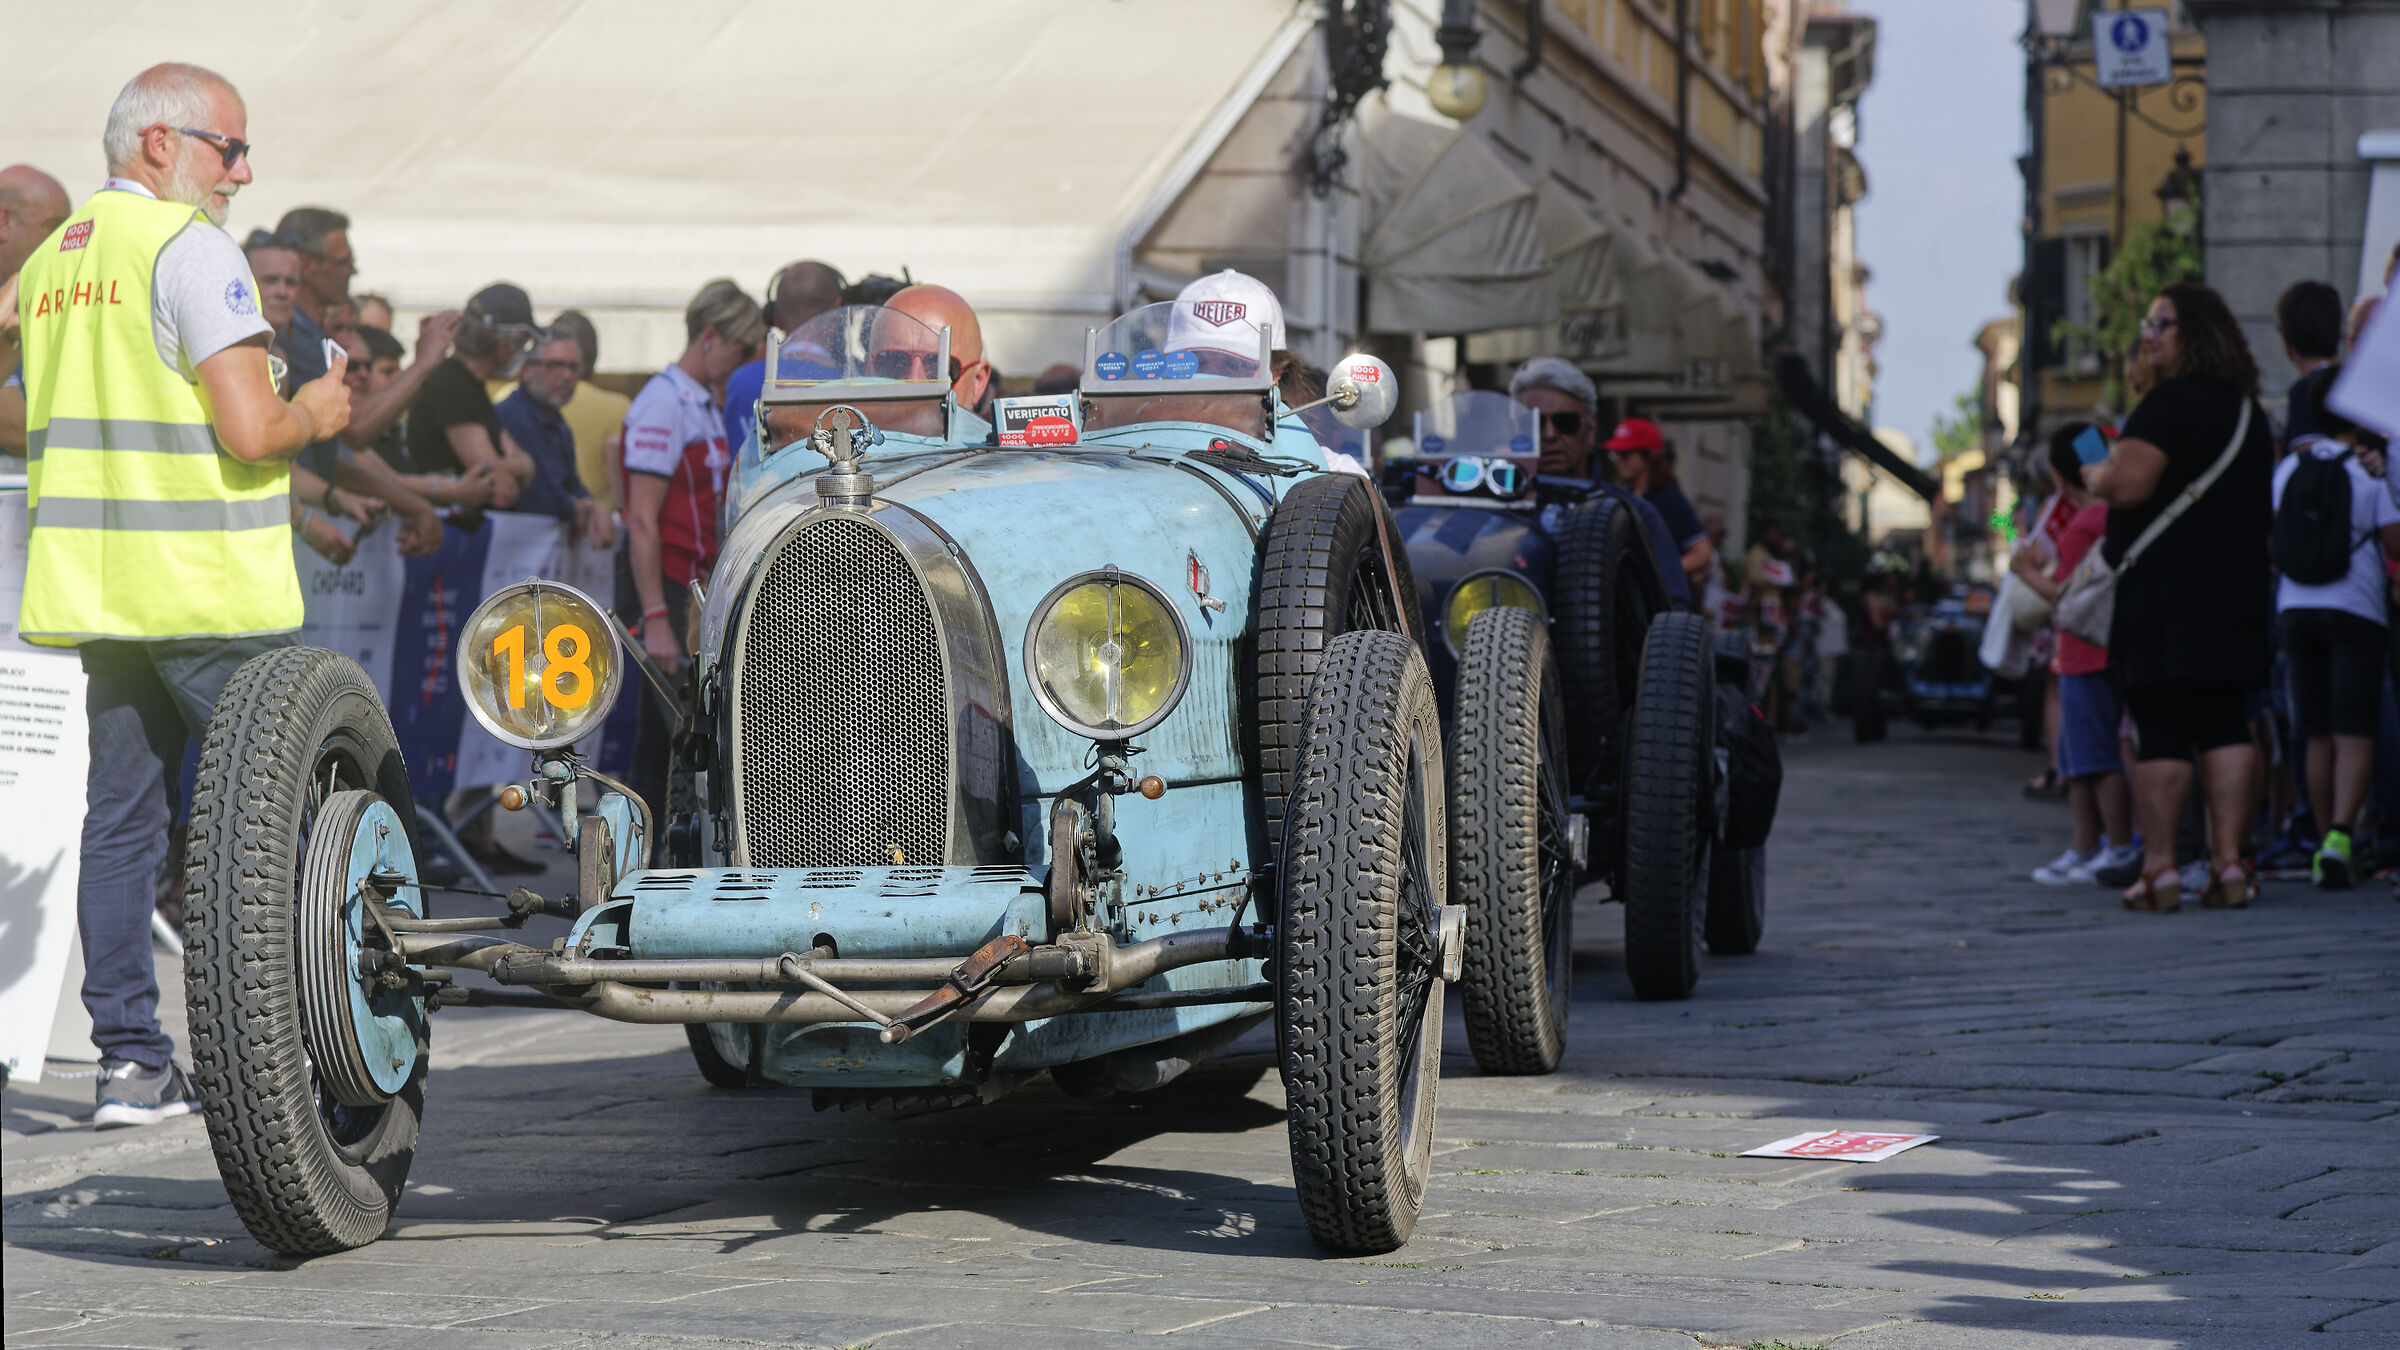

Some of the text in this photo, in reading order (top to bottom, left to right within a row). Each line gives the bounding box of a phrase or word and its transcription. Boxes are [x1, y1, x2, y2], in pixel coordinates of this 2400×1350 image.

[68, 223, 90, 236] 1000
[25, 280, 121, 318] ARHAL
[1197, 303, 1242, 323] HEUER
[1352, 374, 1376, 382] MIGLIA
[1006, 407, 1069, 420] VERIFICATO
[493, 623, 595, 710] 18
